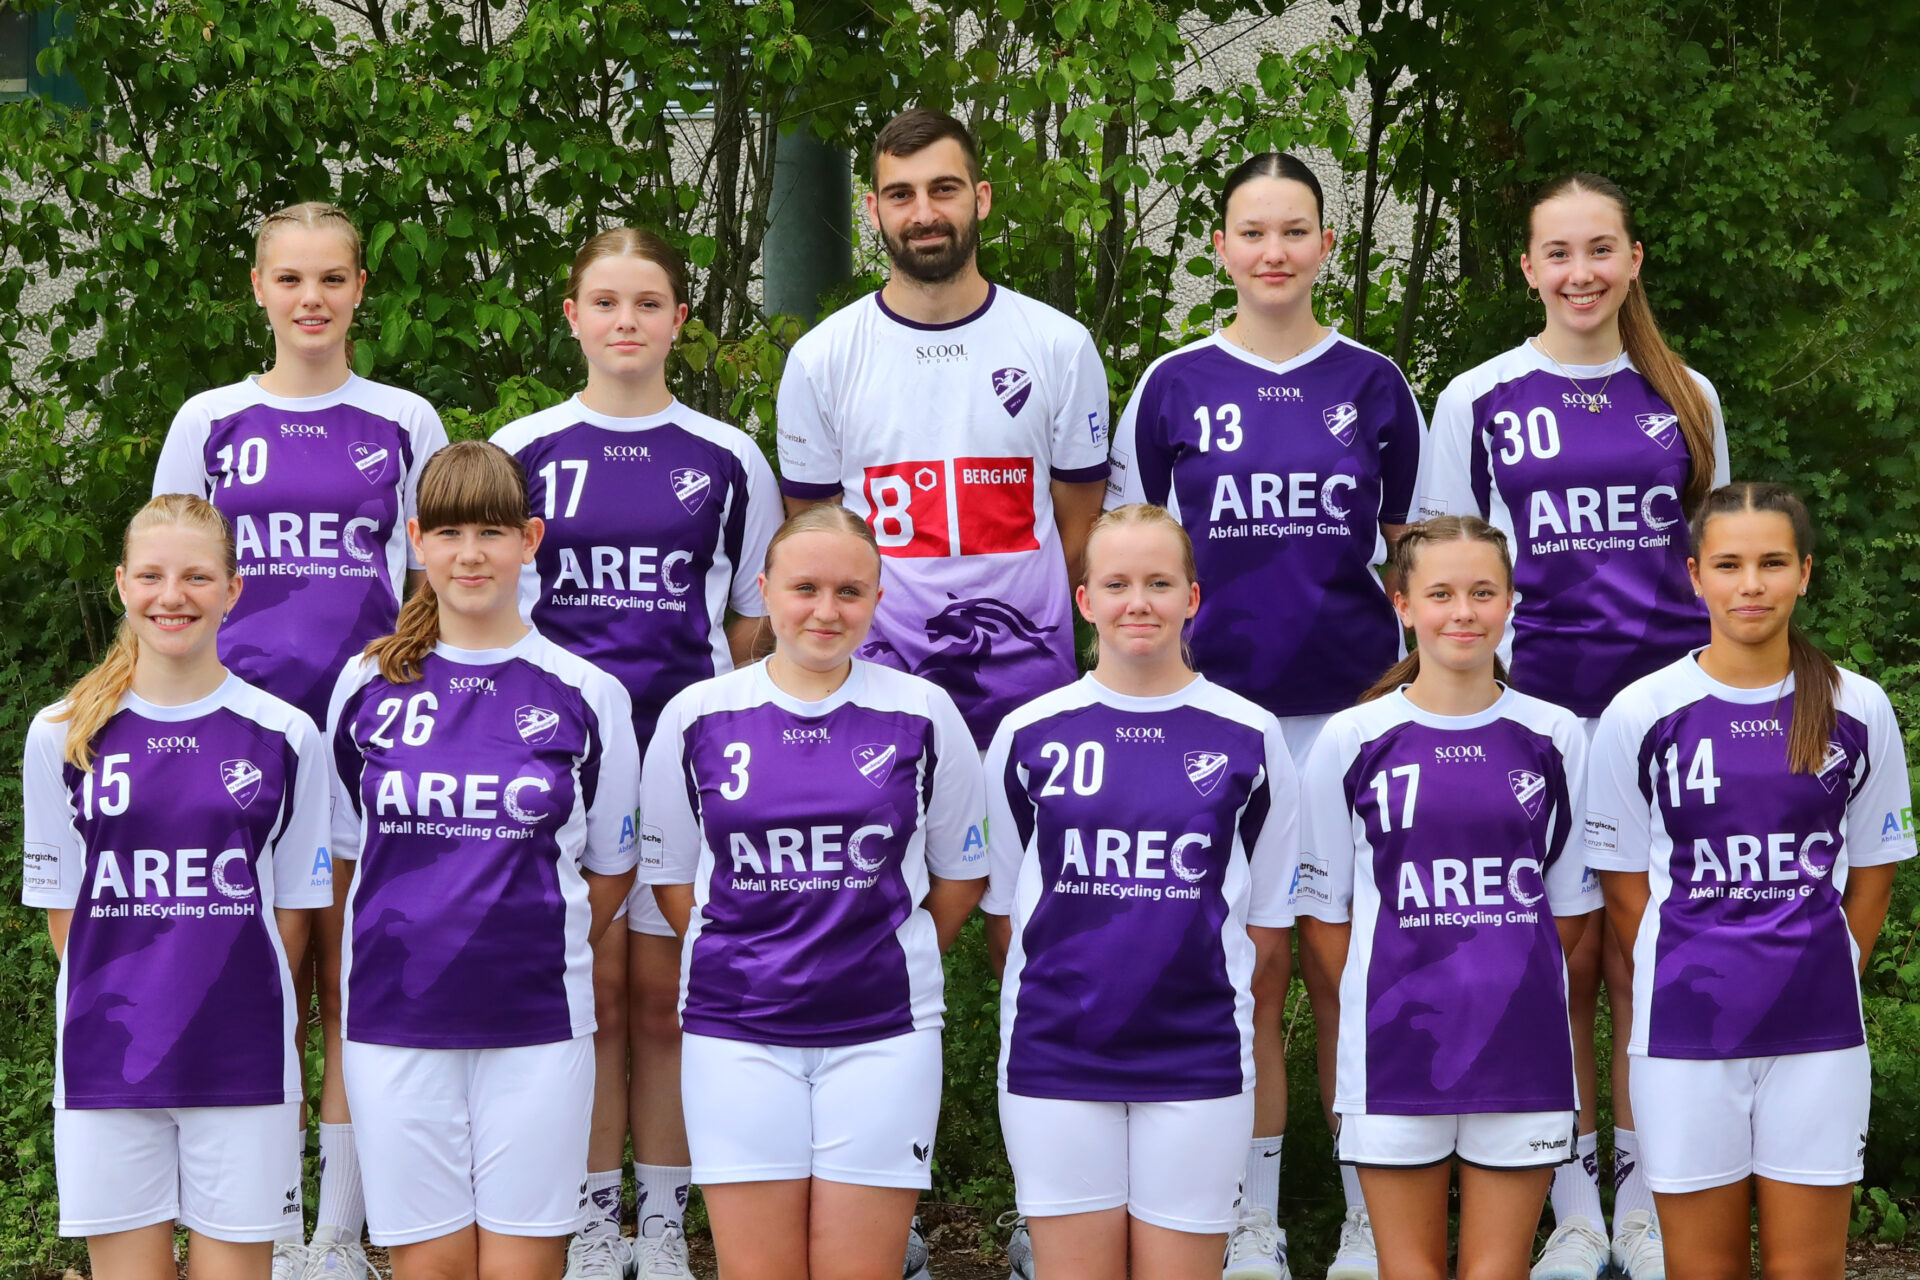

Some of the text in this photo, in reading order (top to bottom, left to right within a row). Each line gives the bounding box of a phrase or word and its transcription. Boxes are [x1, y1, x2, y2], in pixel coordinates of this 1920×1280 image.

[916, 344, 968, 360] S.COOL
[1258, 386, 1302, 397] S.COOL
[1562, 393, 1611, 405] S.COOL
[280, 424, 327, 435] S.COOL
[1194, 403, 1243, 452] 13
[1494, 407, 1560, 465] 30
[604, 446, 651, 457] S.COOL
[217, 437, 268, 488] 10
[963, 468, 1027, 485] BERGHOF
[539, 460, 588, 519] 17
[1210, 473, 1357, 521] AREC
[1529, 486, 1678, 538] AREC
[237, 513, 379, 562] AREC
[1209, 525, 1247, 539] Abfall
[1253, 524, 1314, 540] RECycling
[1532, 535, 1670, 556] Abfall RECycling GmbH
[237, 563, 378, 578] bfall RECycling GmbH
[553, 546, 693, 596] AREC
[552, 595, 686, 612] Abfall RECycling GmbH
[450, 677, 497, 692] S.COOL
[369, 691, 438, 748] 26
[1731, 719, 1783, 734] S.COOL
[147, 736, 199, 749] S.COOL
[783, 728, 831, 740] S.COOL
[1116, 727, 1165, 739] S.COOL
[859, 747, 875, 760] TV
[1435, 745, 1486, 758] S.COOL
[720, 742, 750, 800] 3
[1040, 741, 1104, 797] 20
[1665, 738, 1720, 807] 14
[83, 753, 130, 820] 15
[376, 771, 551, 824] AREC
[1370, 764, 1420, 833] 17
[379, 821, 411, 834] Abfall
[417, 823, 491, 840] RECycling
[729, 824, 894, 873] AREC
[1061, 829, 1212, 883] AREC
[1690, 830, 1834, 880] AREC
[91, 848, 255, 899] AREC
[732, 877, 766, 892] Abfall
[771, 877, 840, 893] RECycling
[1093, 883, 1161, 900] RECycling
[1165, 886, 1200, 900] GmbH
[1398, 857, 1544, 910] AREC
[1729, 887, 1795, 902] RECycling
[90, 903, 255, 919] Abfall RECycling GmbH
[1400, 911, 1538, 928] Abfall RECycling GmbH
